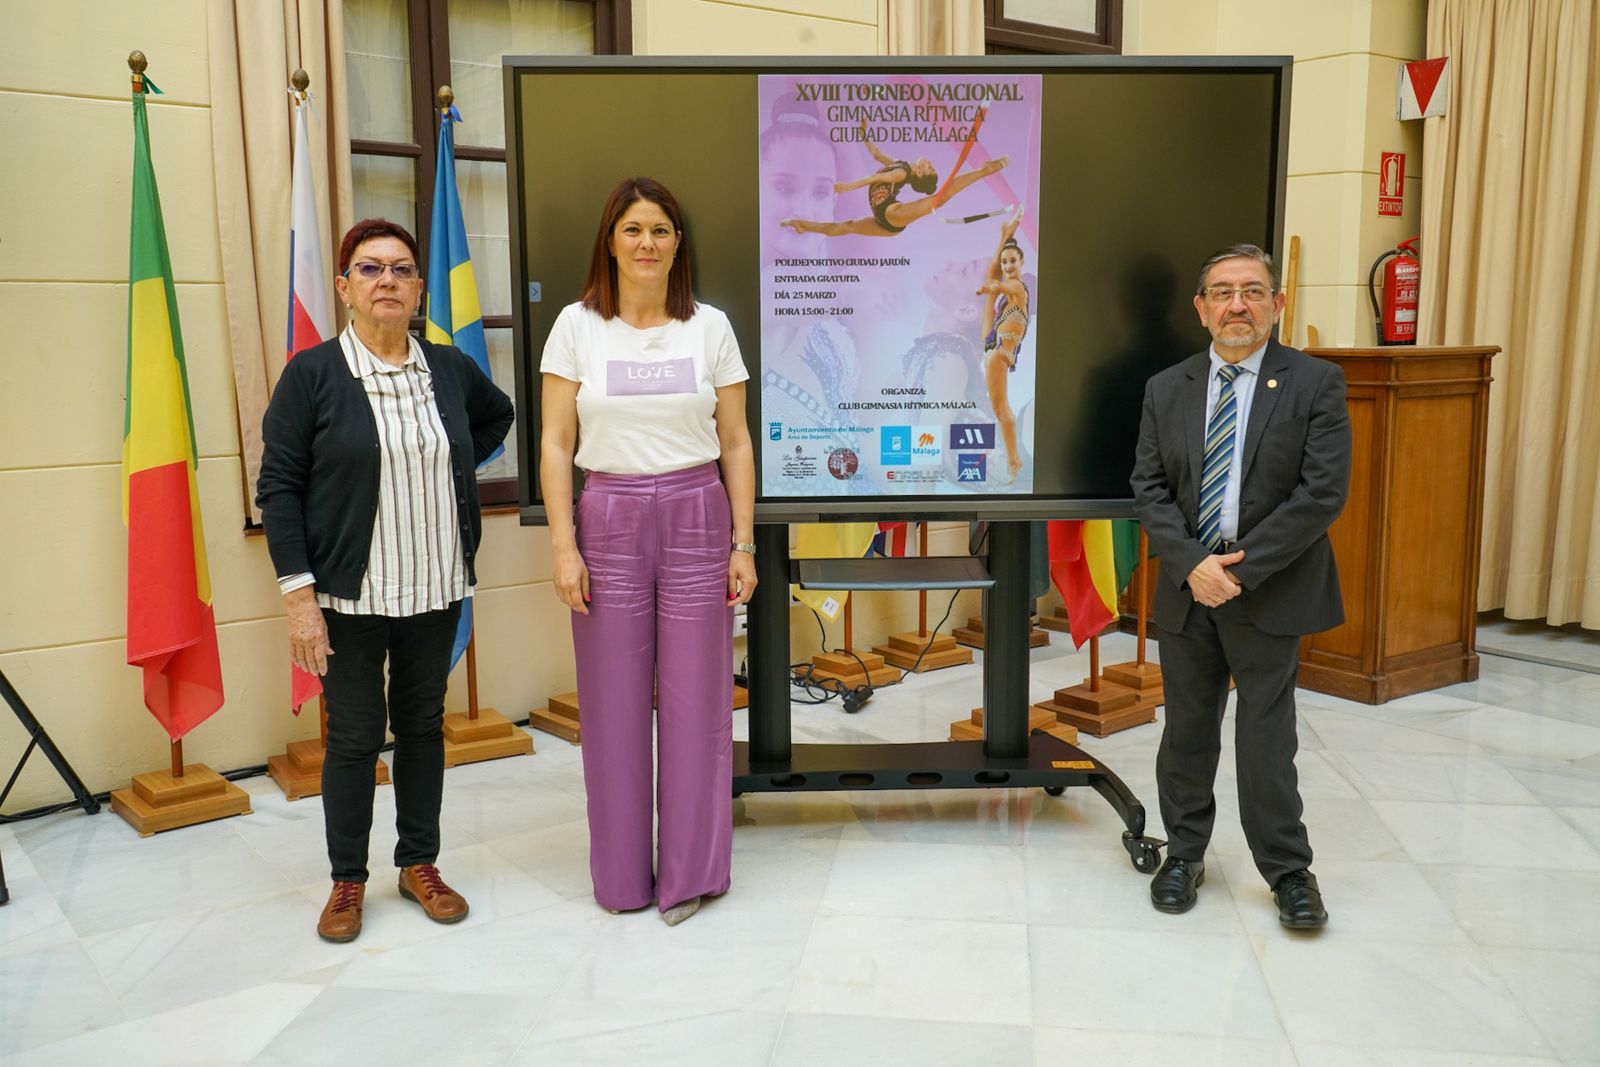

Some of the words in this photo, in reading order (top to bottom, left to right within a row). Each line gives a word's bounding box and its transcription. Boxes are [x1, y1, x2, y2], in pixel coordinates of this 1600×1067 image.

[796, 84, 841, 101] XVIII
[843, 84, 924, 101] TORNEO
[927, 83, 1024, 101] NACIONAL
[827, 105, 912, 122] GIMNASIA
[914, 102, 985, 122] RÍTMICA
[830, 127, 888, 142] CIUDAD
[891, 127, 912, 142] DE
[914, 123, 978, 142] MÁLAGA
[1379, 200, 1402, 212] EXTINTOR
[775, 258, 845, 267] POLIDEPORTIVO
[846, 258, 879, 267] CIUDAD
[879, 257, 911, 267] JARDÍN
[774, 275, 816, 283] ENTRADA
[817, 275, 860, 283] GRATUITA
[774, 290, 791, 299] DÍA
[792, 291, 804, 299] 25
[804, 291, 837, 299] MARZO
[774, 307, 800, 316] HORA
[801, 307, 825, 316] 15:00
[830, 307, 854, 316] 21:00
[627, 365, 676, 379] LOVE
[881, 387, 927, 396] ORGANIZA:
[838, 402, 860, 411] CLUB
[861, 401, 903, 410] GIMNASIA
[903, 400, 940, 410] RÍTMICA
[941, 400, 977, 410] MÁLAGA
[848, 426, 875, 434] Málaga
[912, 447, 941, 456] Málaga
[959, 468, 982, 480] AXA
